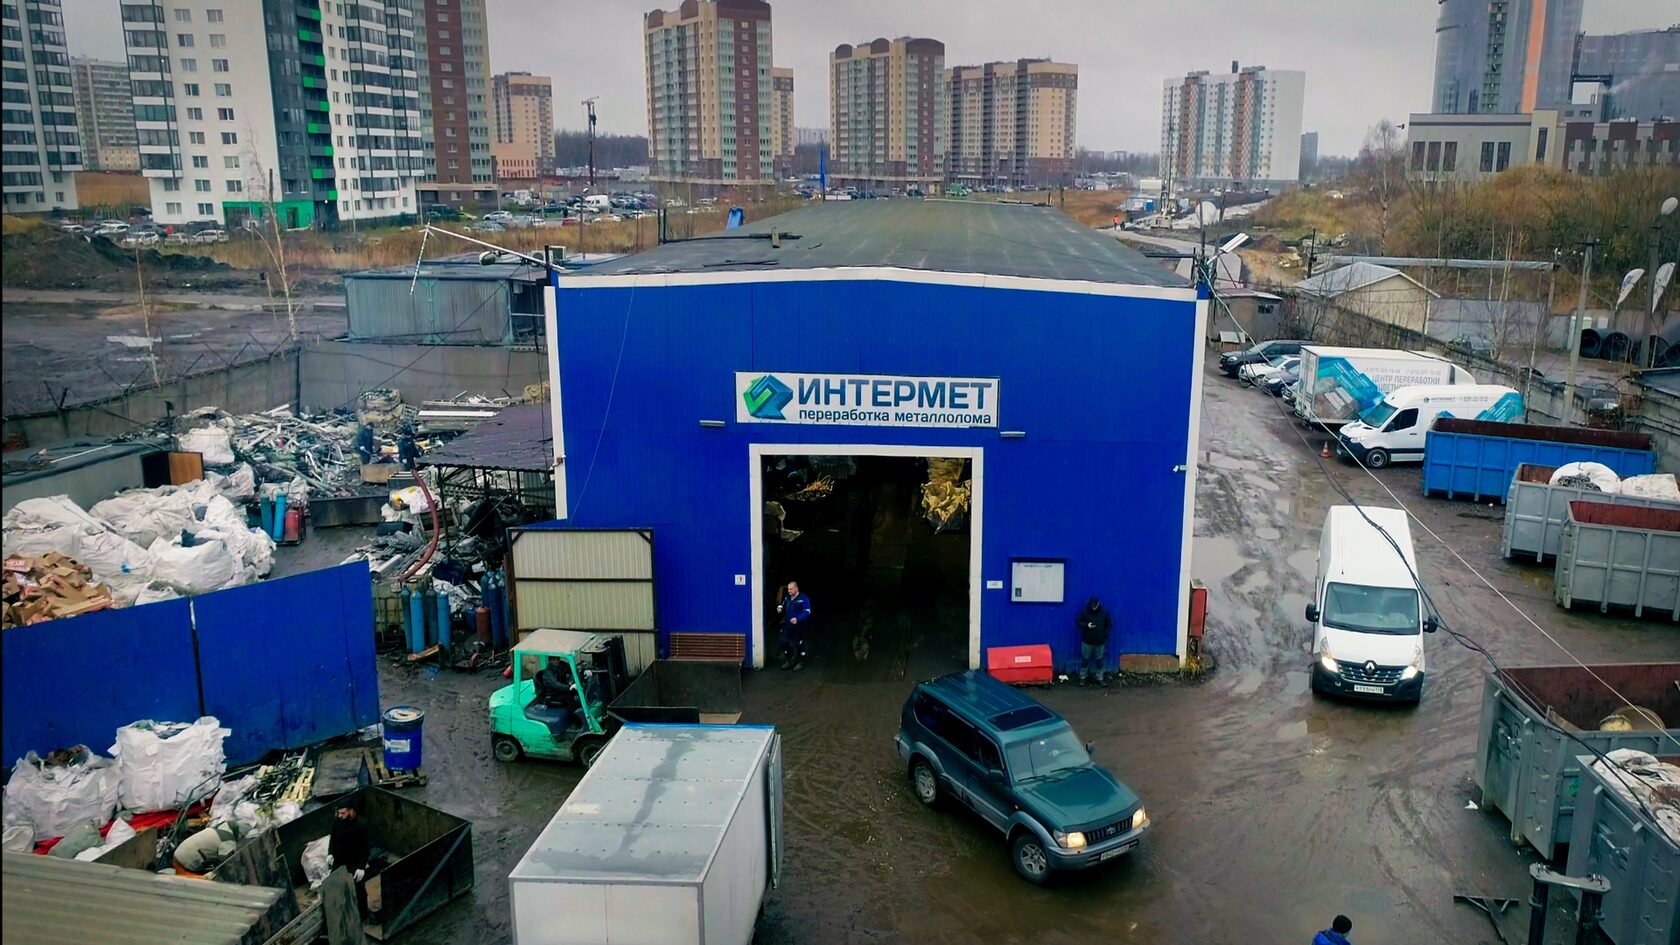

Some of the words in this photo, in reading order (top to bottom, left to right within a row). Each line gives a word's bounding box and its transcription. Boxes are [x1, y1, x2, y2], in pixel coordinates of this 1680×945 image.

[1372, 374, 1393, 384] ЦЕНТР
[1394, 375, 1441, 385] ПЕРЕРАБОТКИ
[798, 377, 992, 409] ИНТЕРМЕТ
[799, 408, 890, 423] переработка
[894, 411, 992, 424] металлолома
